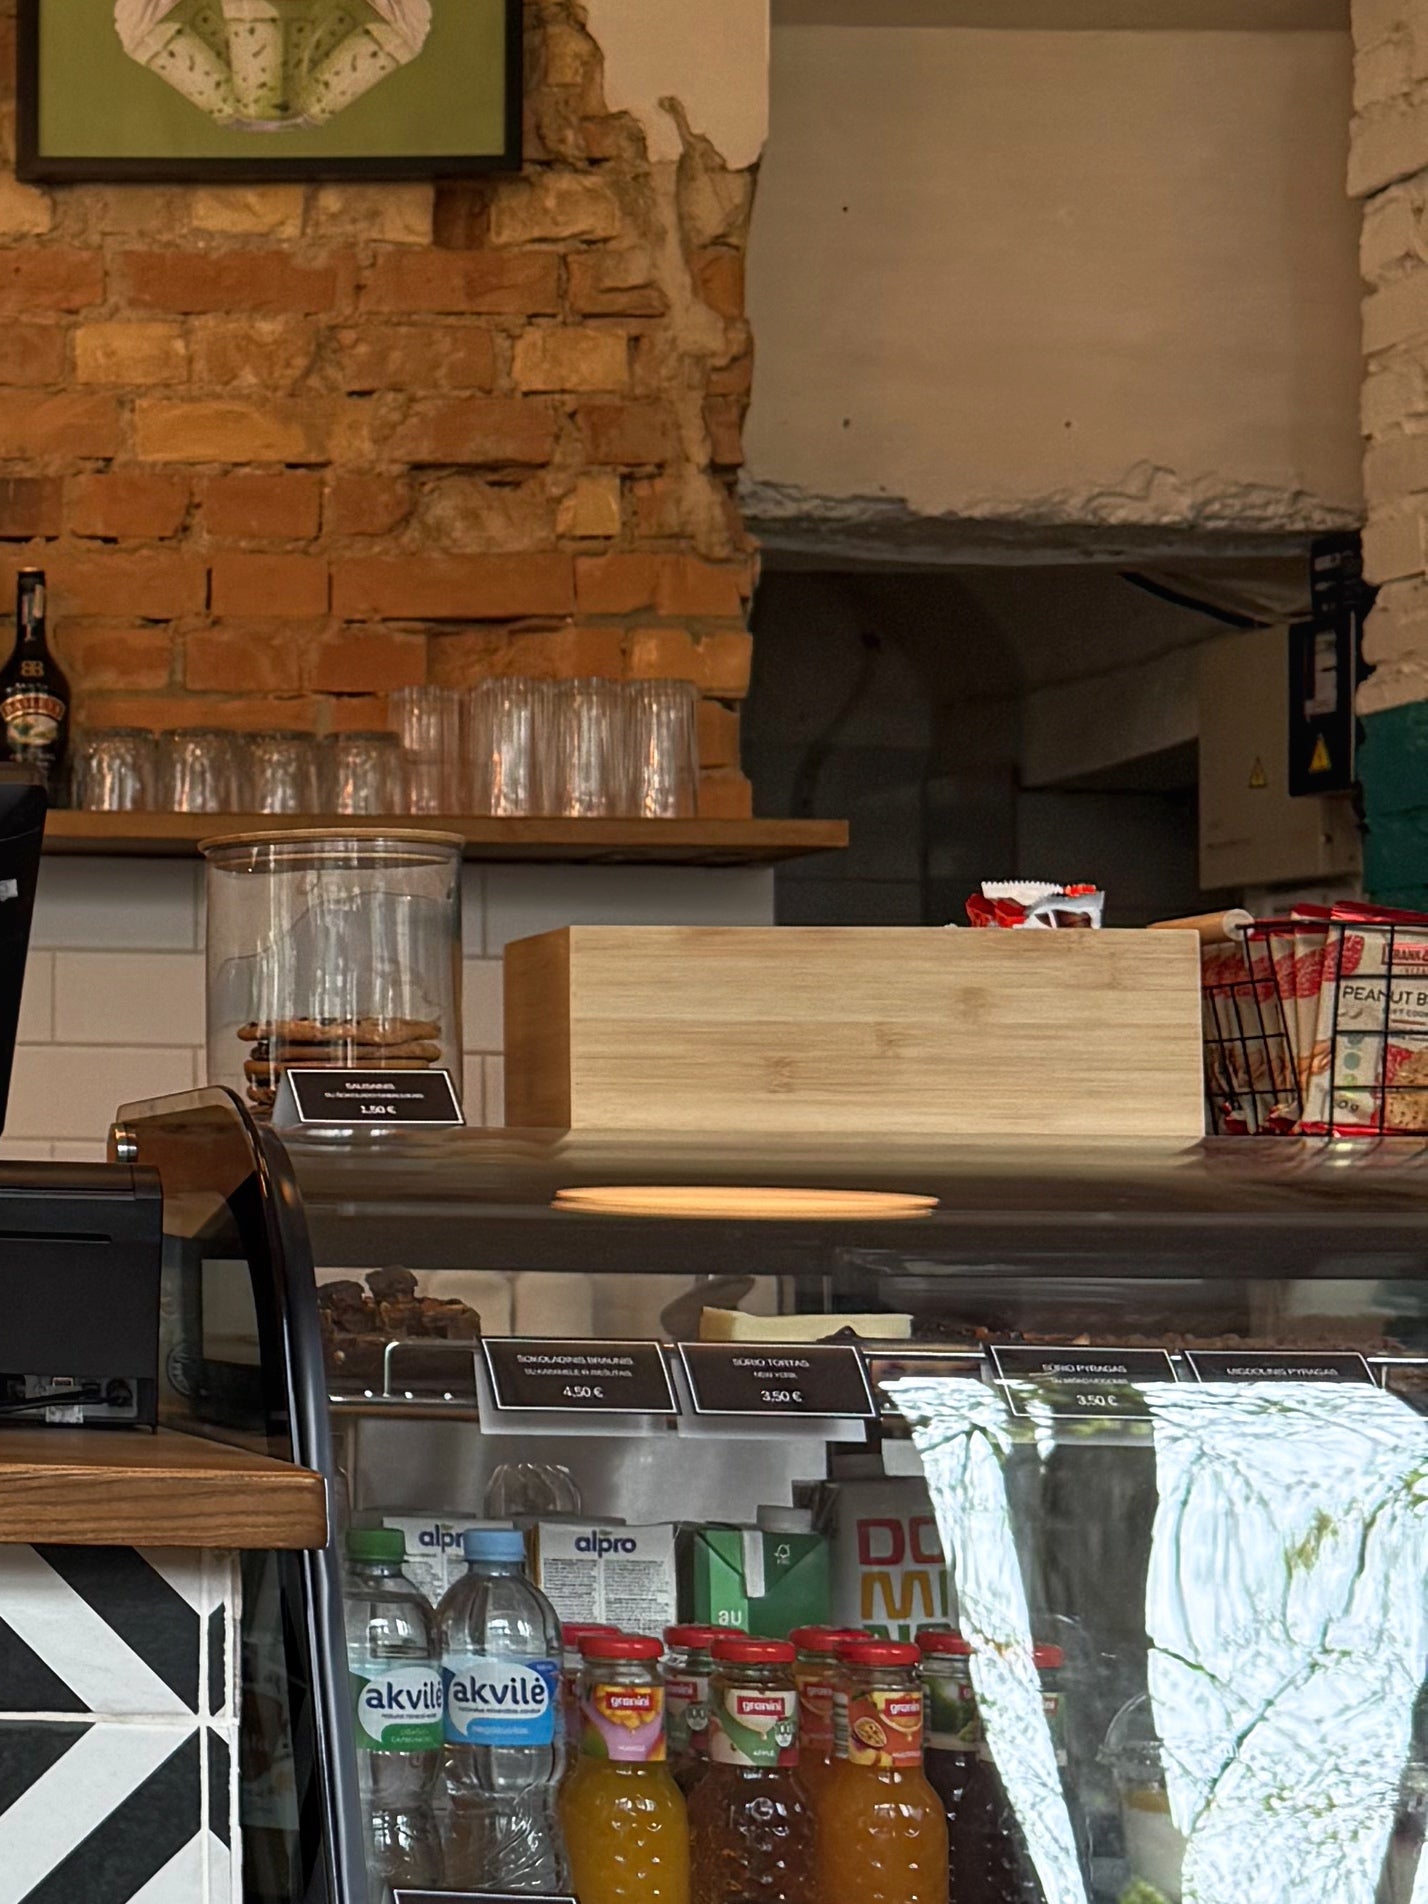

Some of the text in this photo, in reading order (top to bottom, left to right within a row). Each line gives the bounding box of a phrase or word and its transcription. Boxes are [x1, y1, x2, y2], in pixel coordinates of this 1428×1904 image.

[1343, 985, 1414, 1004] PEANUT
[761, 1391, 802, 1402] 3,50 €
[575, 1530, 637, 1558] alpro
[452, 1676, 545, 1705] akvilė
[611, 1695, 782, 1712] granini granini
